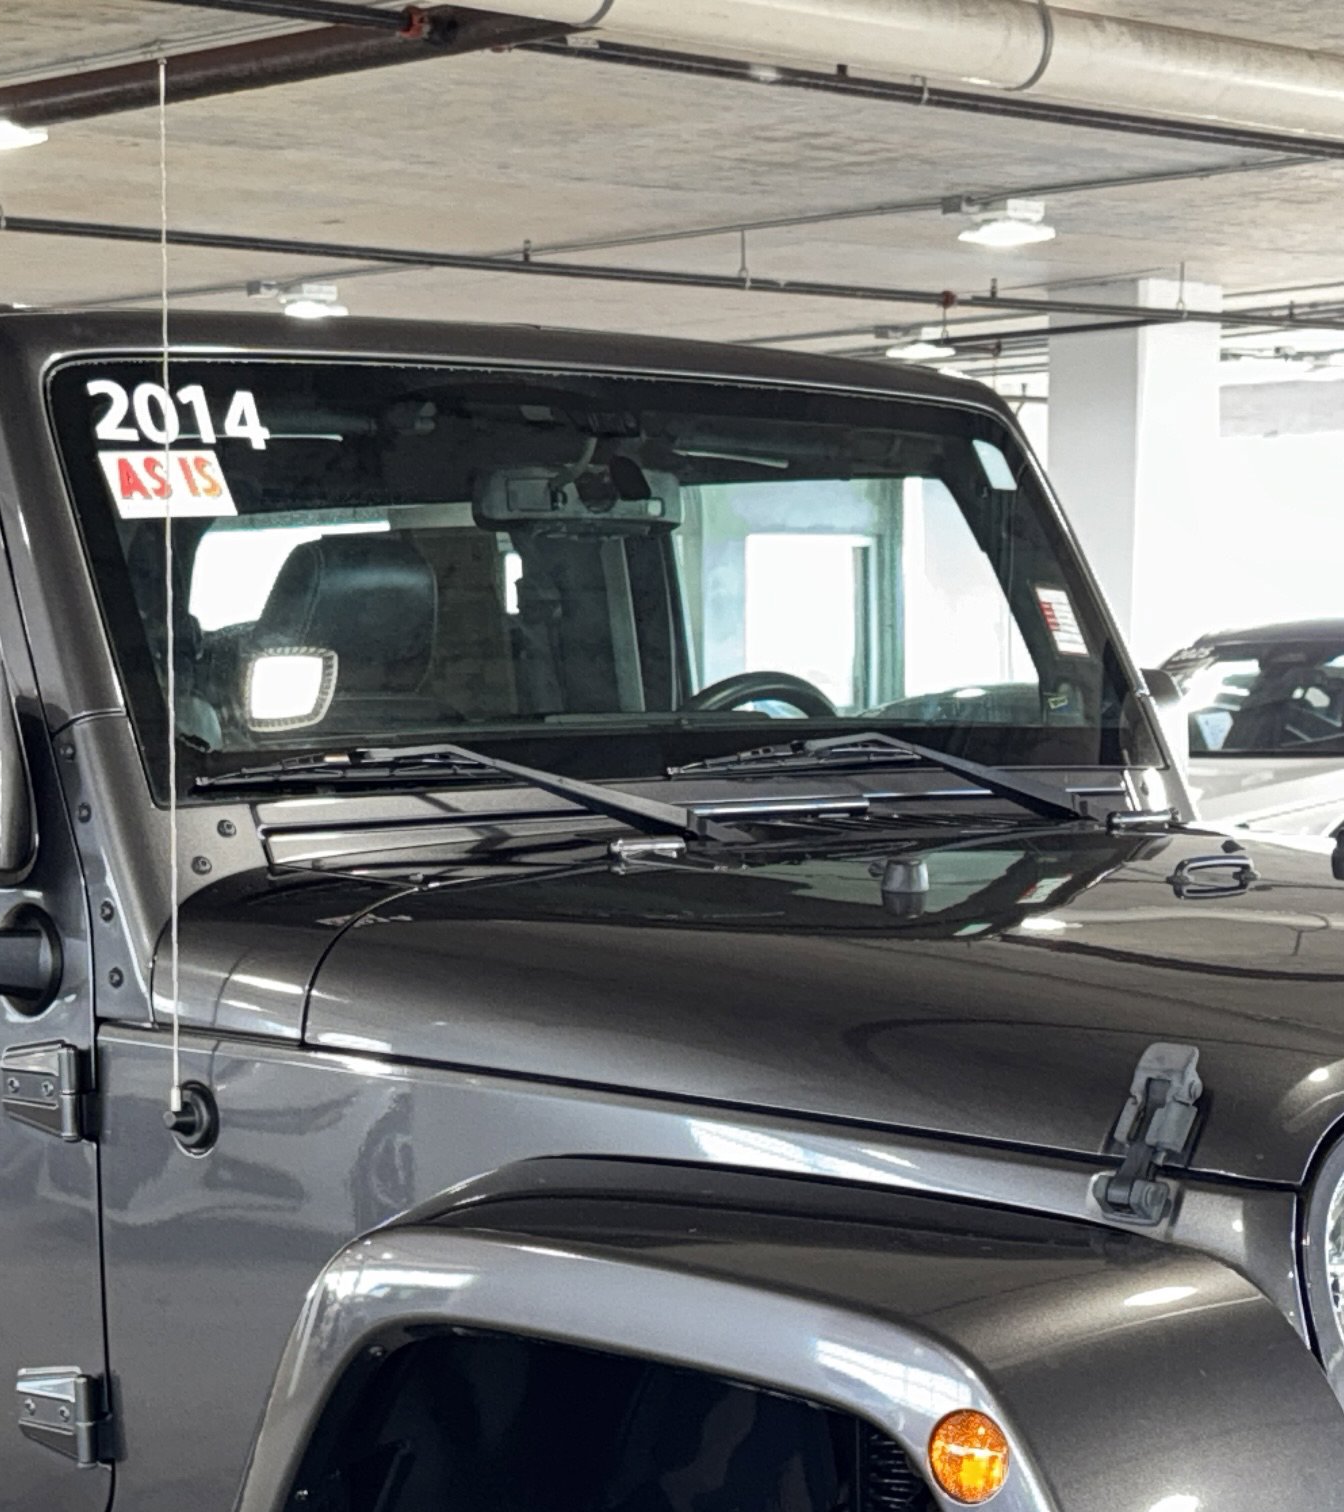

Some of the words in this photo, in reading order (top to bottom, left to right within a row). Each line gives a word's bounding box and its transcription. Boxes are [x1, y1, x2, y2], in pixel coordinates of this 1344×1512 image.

[86, 379, 271, 450] 2014
[117, 456, 172, 500] AS
[178, 456, 222, 498] IS
